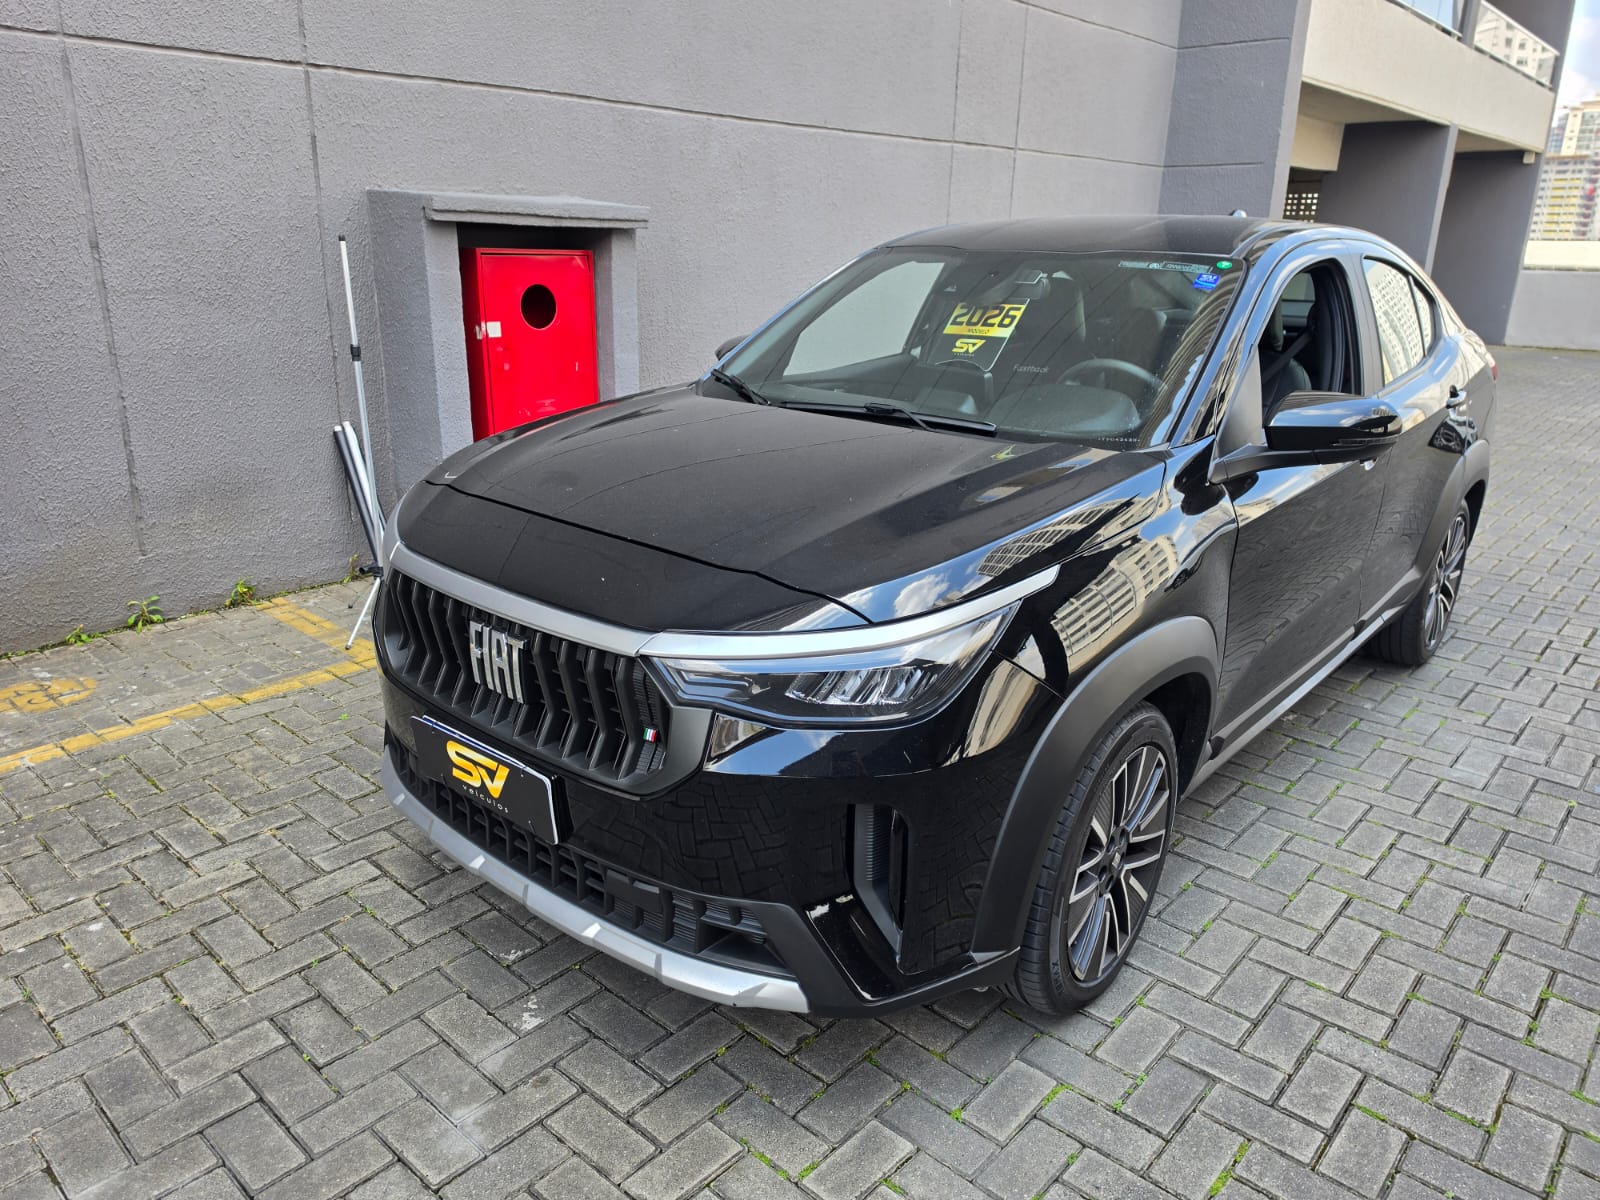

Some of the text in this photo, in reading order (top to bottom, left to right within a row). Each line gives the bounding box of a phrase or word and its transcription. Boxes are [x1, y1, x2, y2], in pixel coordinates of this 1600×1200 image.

[950, 303, 1023, 328] 2026
[952, 338, 987, 354] SV
[470, 621, 525, 704] FIAT
[446, 740, 510, 798] SV
